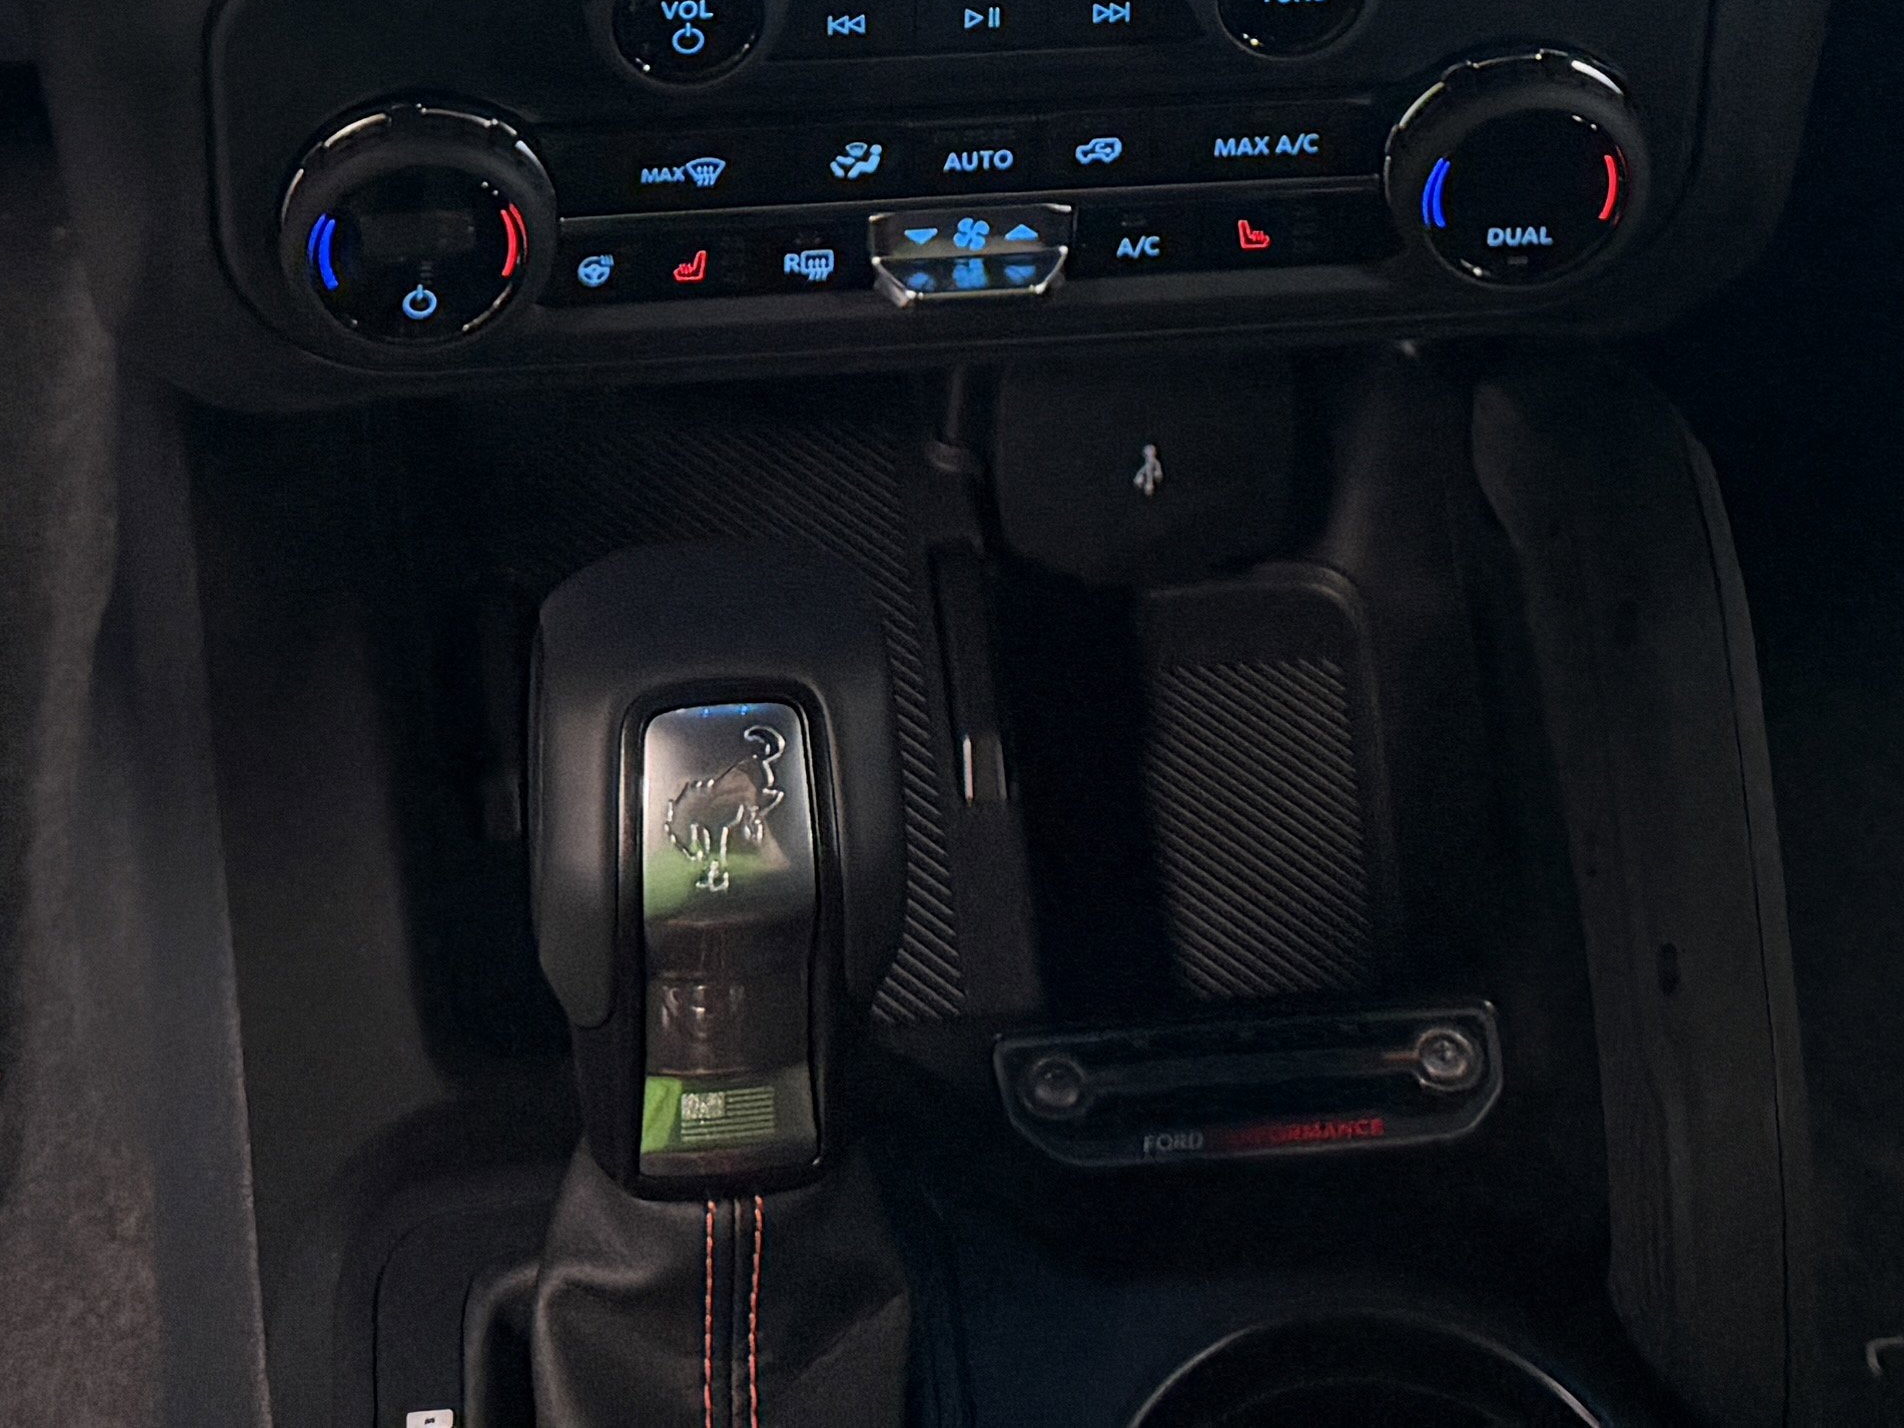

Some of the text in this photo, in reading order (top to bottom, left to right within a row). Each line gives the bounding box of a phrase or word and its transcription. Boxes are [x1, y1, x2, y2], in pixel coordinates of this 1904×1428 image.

[661, 0, 715, 22] VOL
[1213, 132, 1320, 158] MAX A/C
[943, 147, 1014, 173] AUTO
[640, 165, 685, 186] MAX
[1116, 235, 1161, 259] A/C
[1486, 226, 1554, 248] DUAL
[1142, 1129, 1204, 1153] FORD
